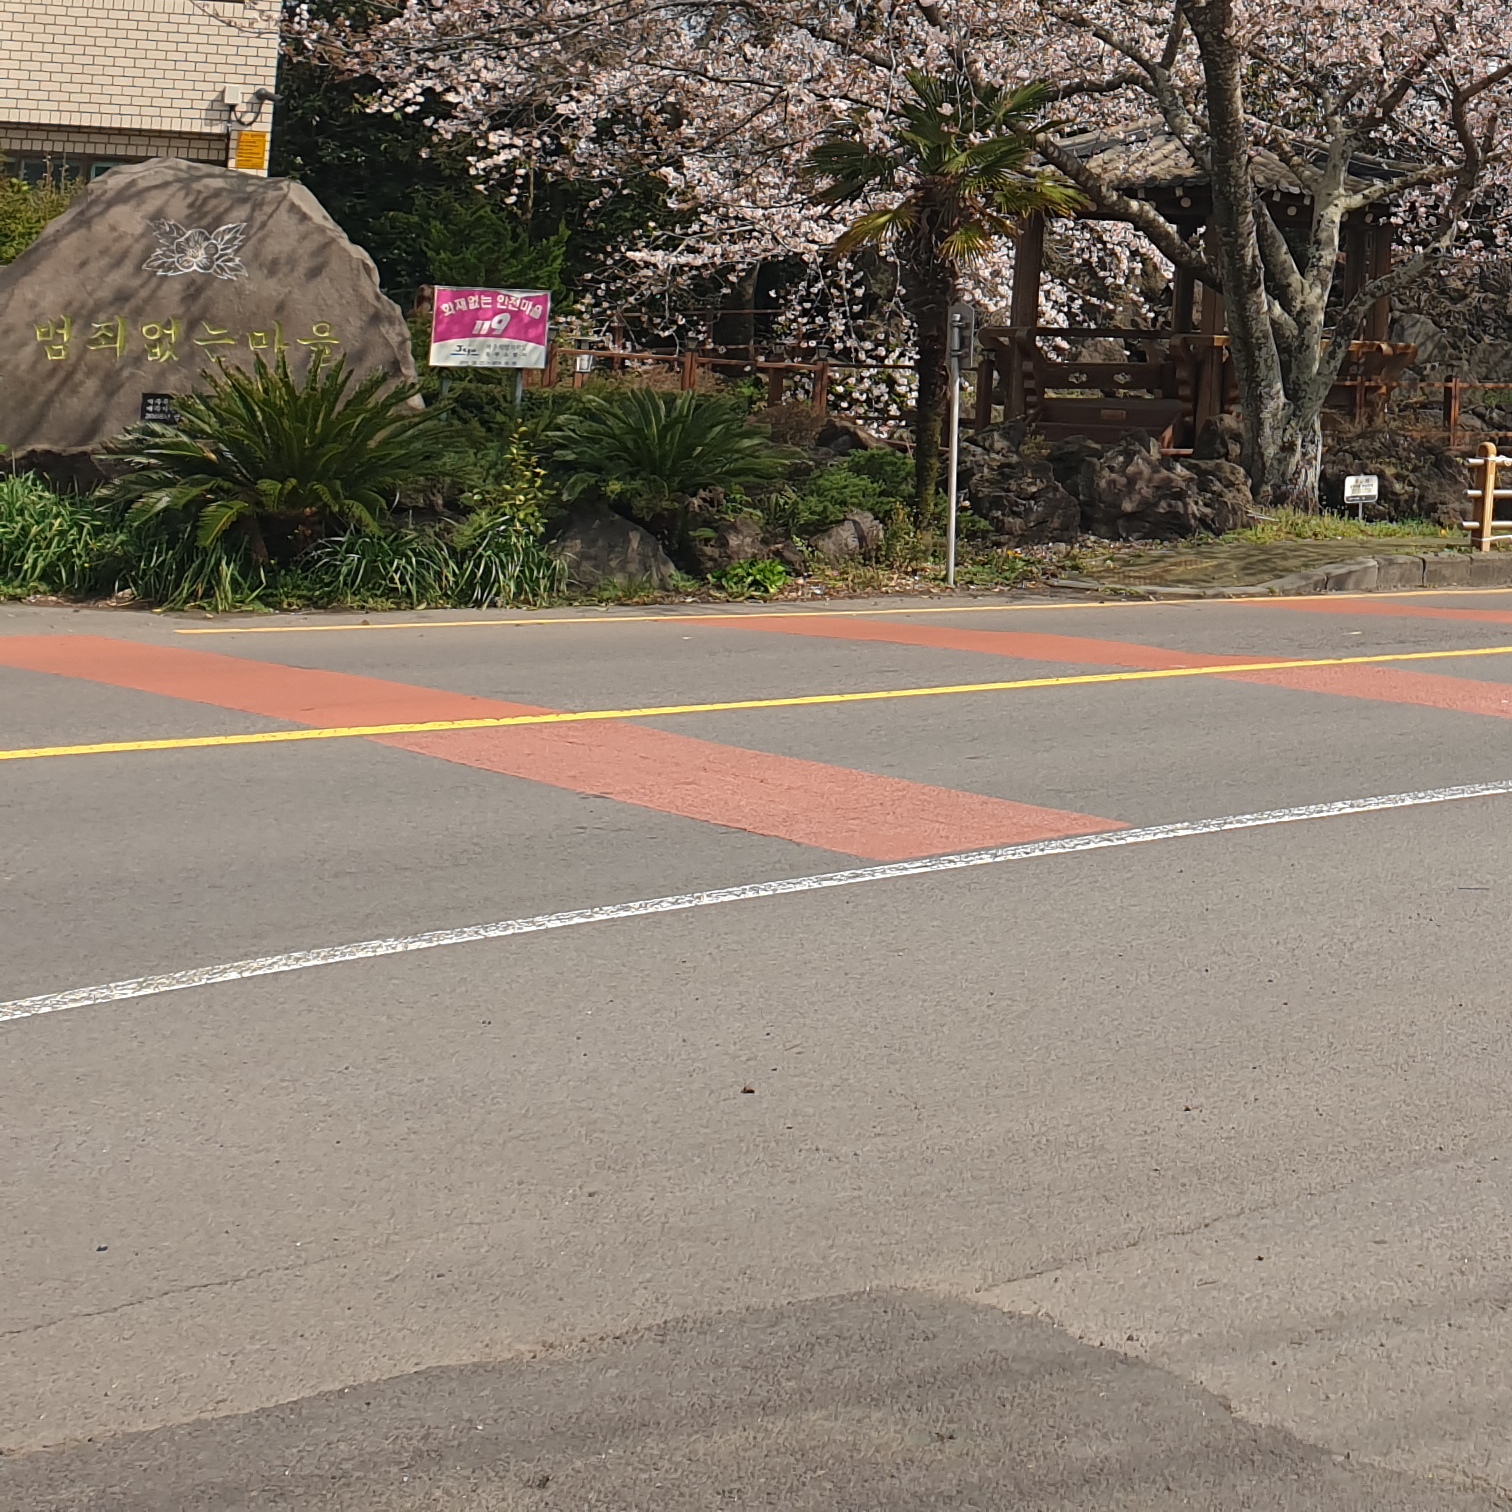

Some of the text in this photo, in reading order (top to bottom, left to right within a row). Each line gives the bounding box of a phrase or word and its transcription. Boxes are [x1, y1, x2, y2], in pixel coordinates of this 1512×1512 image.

[440, 294, 543, 319] 화재없는 안전마을
[472, 313, 511, 334] 119
